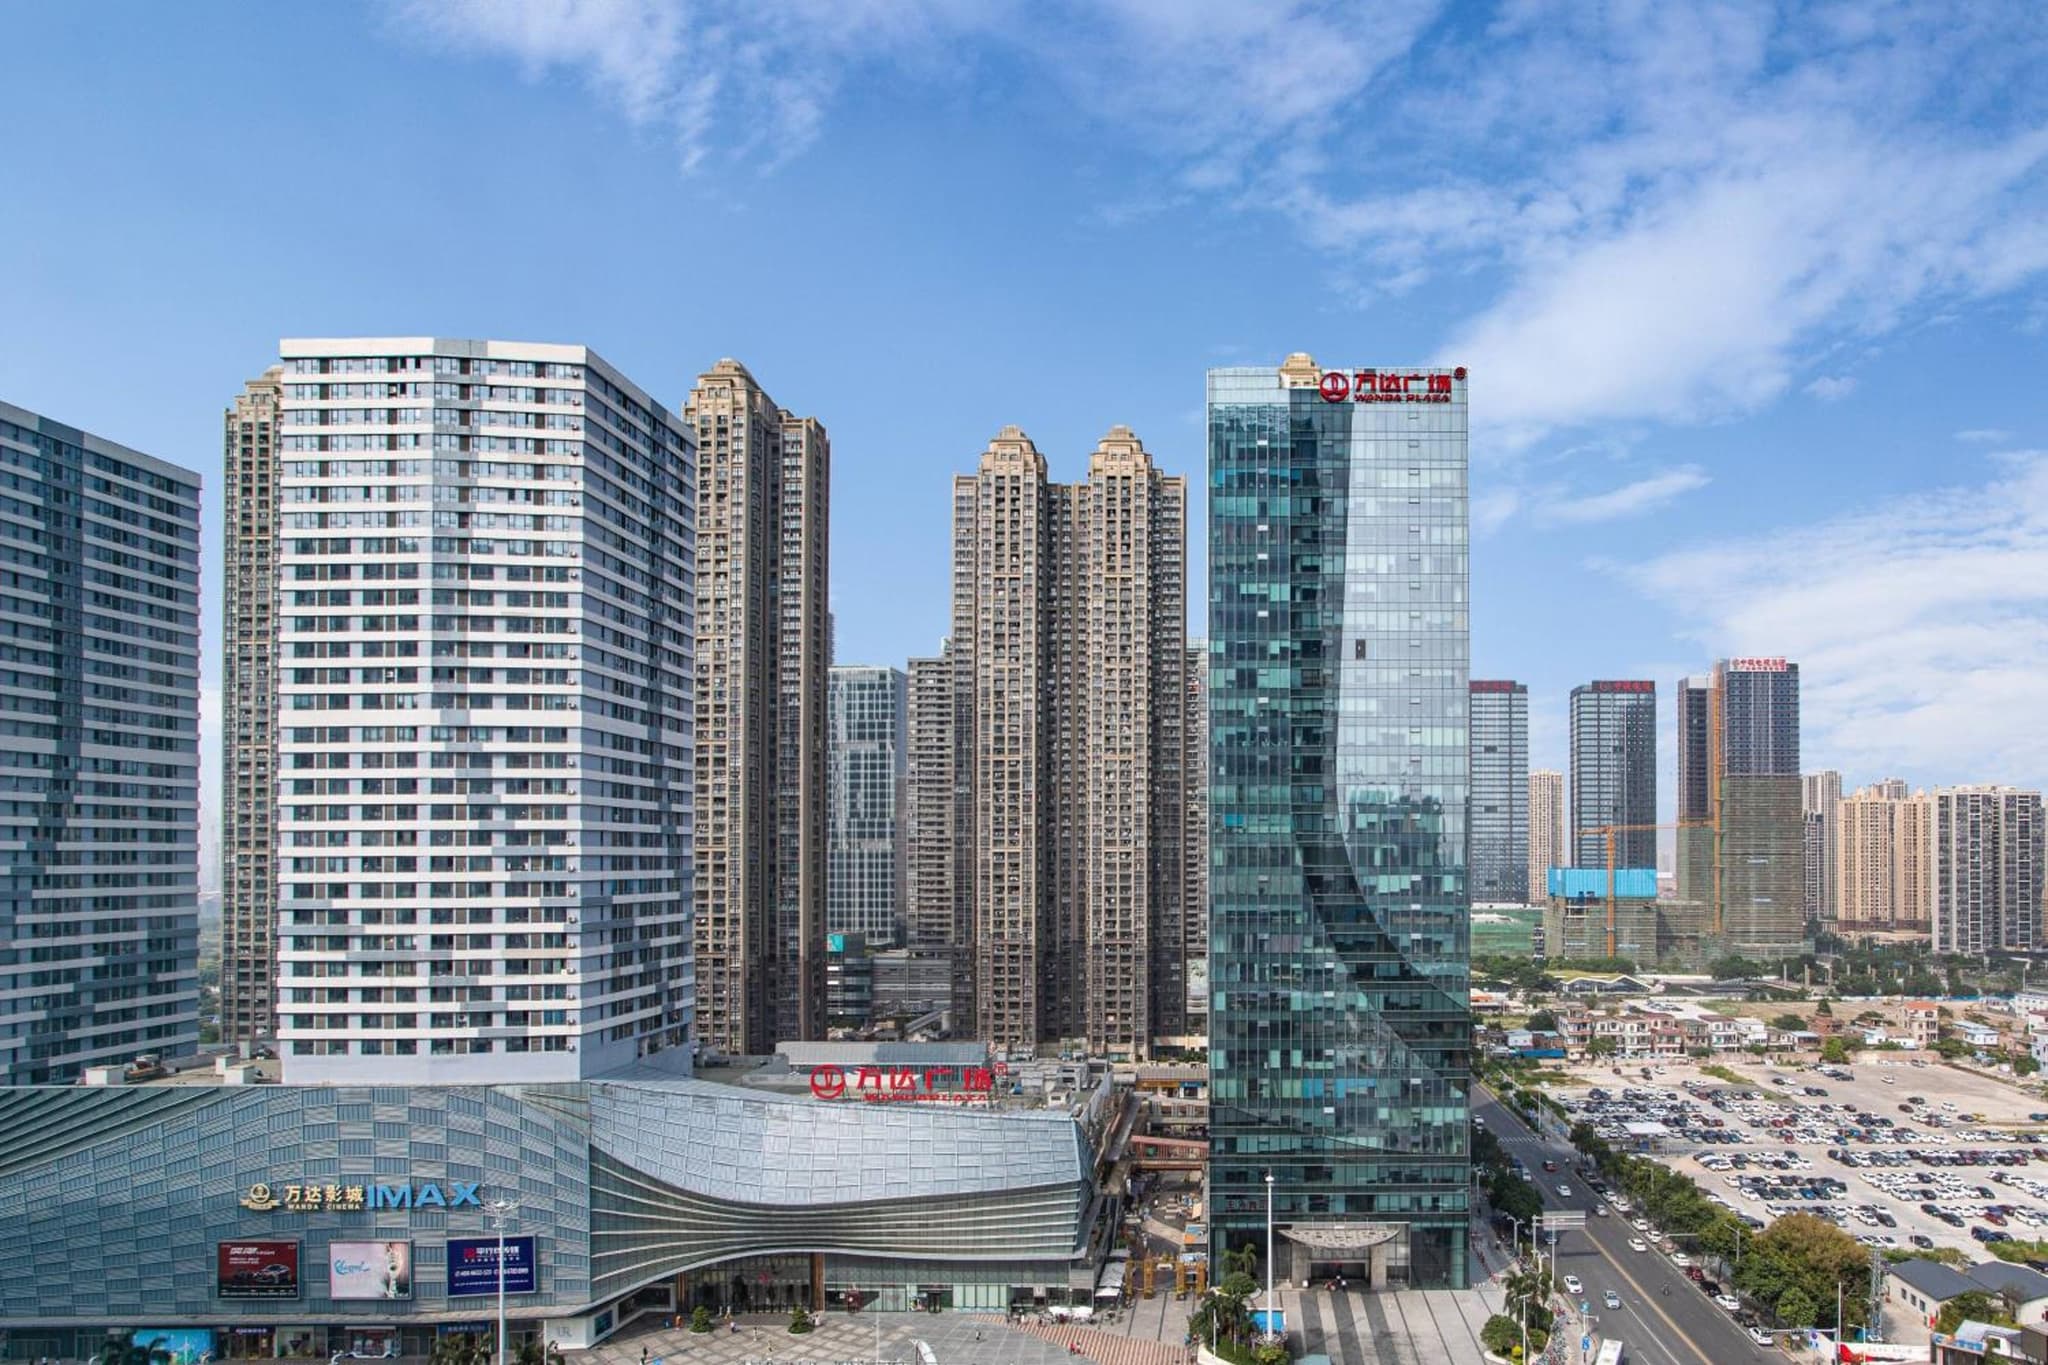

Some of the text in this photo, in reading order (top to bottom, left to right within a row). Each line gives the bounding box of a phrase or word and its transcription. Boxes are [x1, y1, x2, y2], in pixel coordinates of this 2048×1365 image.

[1354, 373, 1453, 393] 万达广场
[1354, 394, 1451, 403] WANDA PLAZA
[856, 1066, 993, 1091] 万达广场
[285, 1184, 364, 1202] 万达影城
[367, 1182, 481, 1208] IMAX
